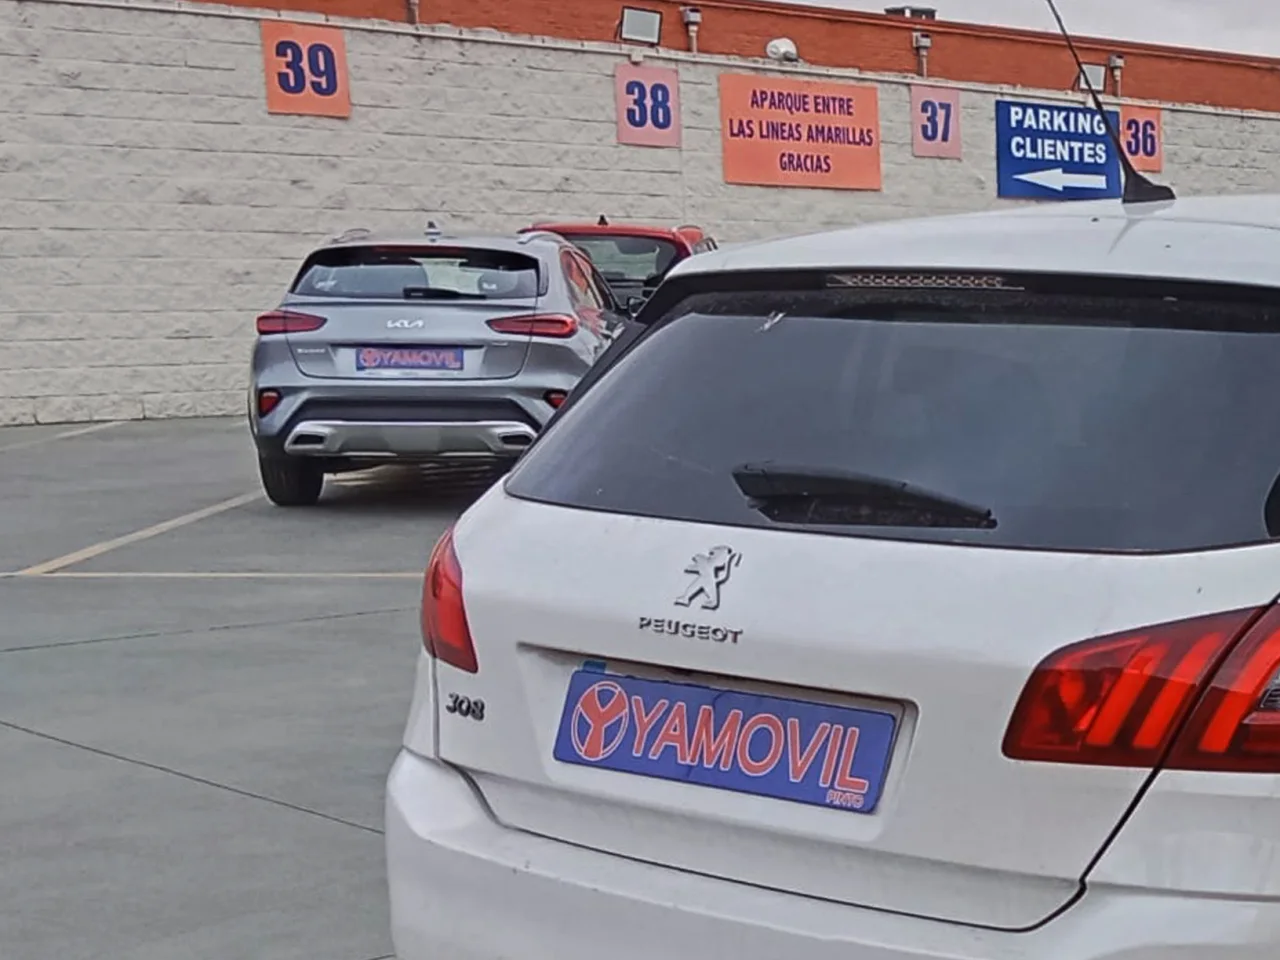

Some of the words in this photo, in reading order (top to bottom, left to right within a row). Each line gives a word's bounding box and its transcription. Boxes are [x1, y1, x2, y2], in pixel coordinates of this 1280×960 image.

[275, 39, 337, 96] 39
[626, 79, 671, 130] 38
[750, 89, 811, 114] APARQUE
[813, 96, 854, 116] ENTRE
[729, 119, 755, 138] LAS
[759, 121, 802, 143] LINEAS
[806, 125, 873, 147] AMARILLAS
[920, 100, 952, 142] 37
[1010, 106, 1106, 136] PARKING
[1011, 137, 1107, 164] CLIENTES
[1126, 118, 1156, 157] 36
[779, 152, 831, 173] GRACIAS
[638, 616, 744, 645] PEUGEOT
[445, 692, 486, 721] 308
[631, 696, 869, 794] YAMOVIL
